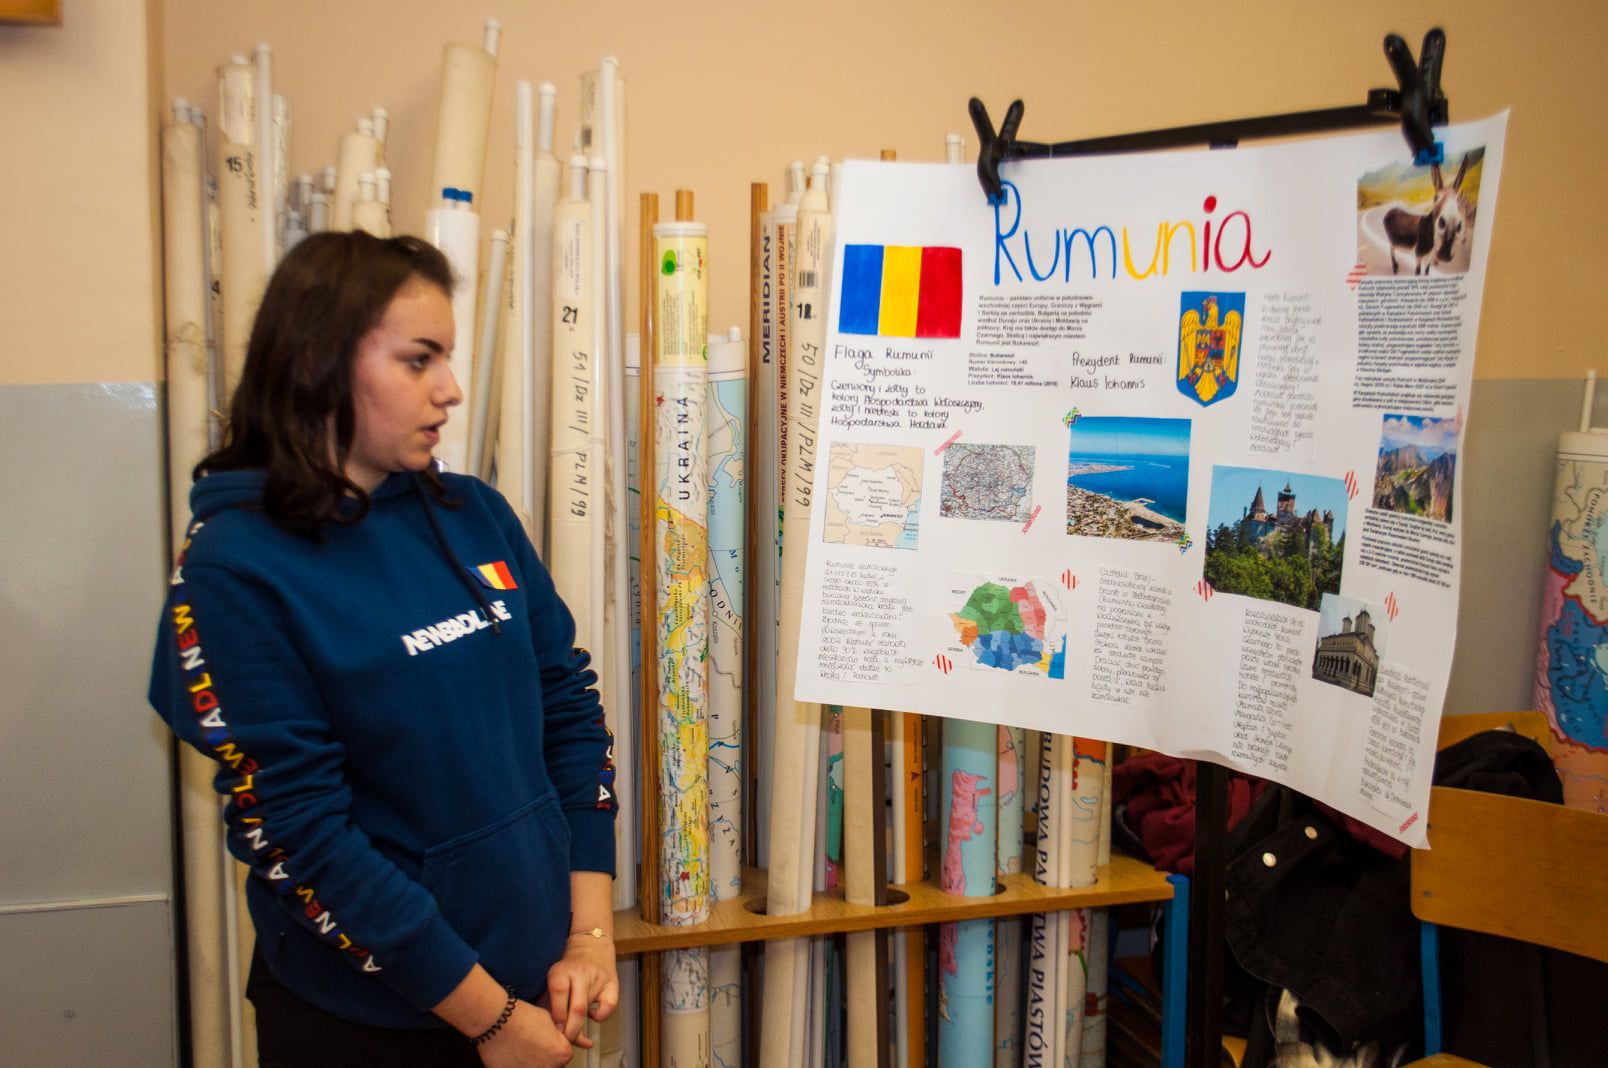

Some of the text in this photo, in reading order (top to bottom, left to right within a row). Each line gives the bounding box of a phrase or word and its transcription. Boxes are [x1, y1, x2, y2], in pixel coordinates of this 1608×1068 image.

[226, 156, 242, 172] 15
[777, 224, 785, 262] WOJNIE
[994, 180, 1272, 286] Rumunia
[778, 271, 785, 286] PO
[762, 235, 771, 364] MERIDIAN
[778, 288, 786, 326] AUSTRII
[562, 306, 578, 324] 21
[779, 333, 787, 390] NIEMCZECH
[834, 344, 934, 370] Flaga Rumunii
[1072, 352, 1120, 375] Prezydent
[831, 380, 876, 397] Czerwony
[915, 384, 926, 395] to
[1070, 375, 1099, 389] Klaus
[907, 408, 918, 418] to
[677, 397, 690, 500] UKRAINA
